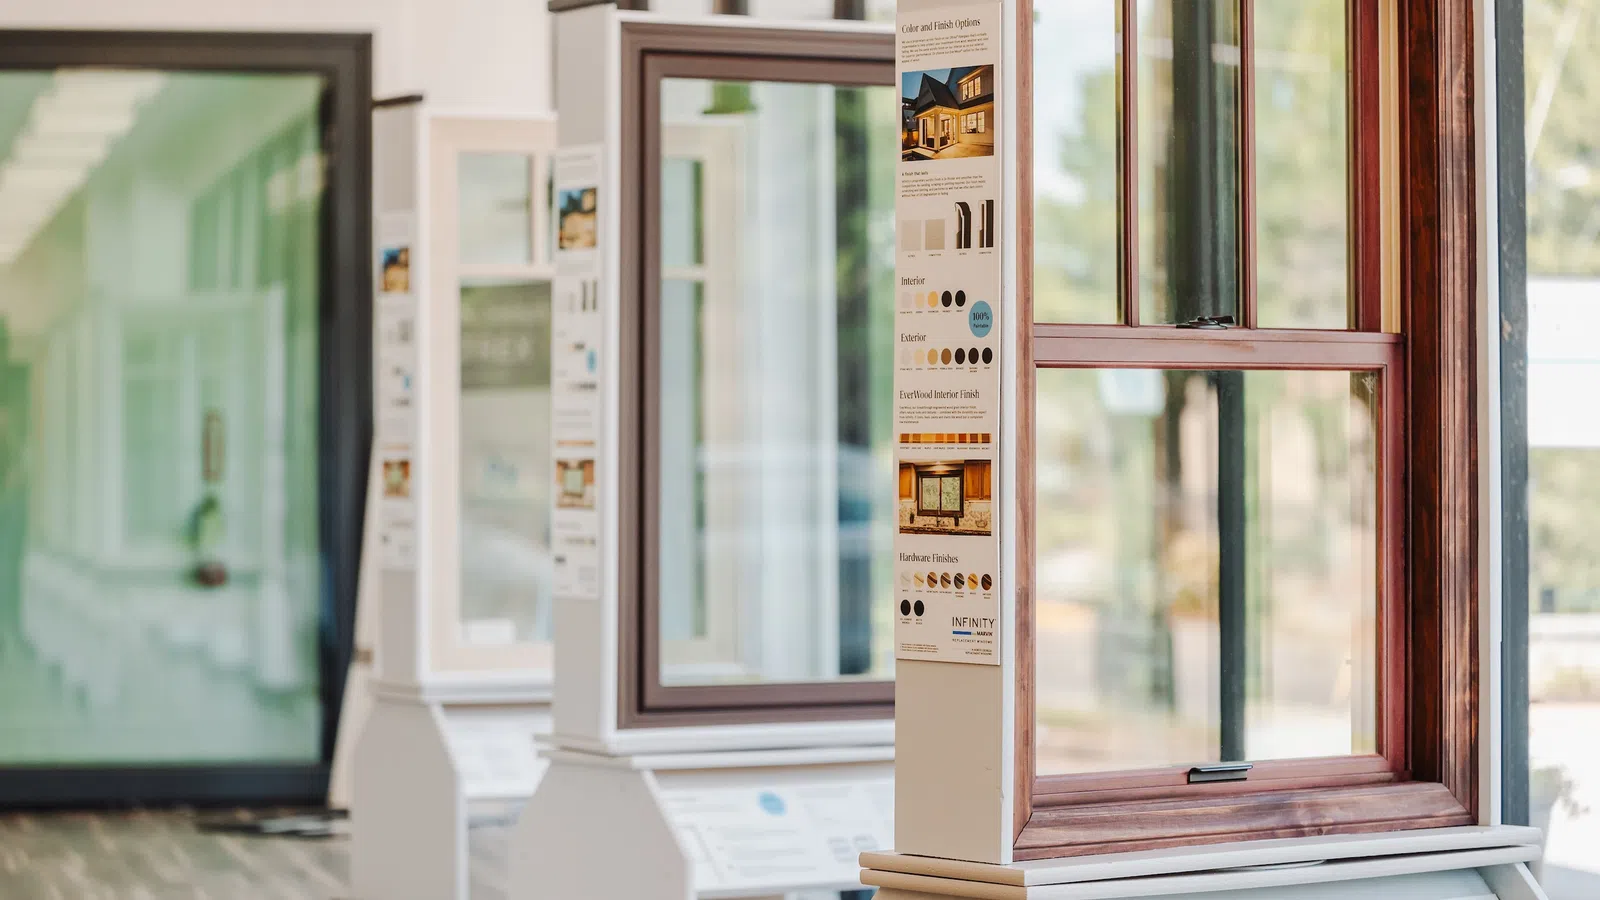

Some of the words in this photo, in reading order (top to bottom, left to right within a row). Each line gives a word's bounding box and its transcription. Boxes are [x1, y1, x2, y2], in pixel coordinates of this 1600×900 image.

[901, 24, 919, 34] Color
[920, 22, 932, 32] and
[934, 20, 954, 30] Finish
[954, 18, 980, 30] Options
[901, 276, 926, 286] Interior
[972, 312, 990, 320] 100%
[900, 333, 926, 342] Exterior
[900, 390, 932, 399] EverWood
[934, 390, 958, 399] Interior
[960, 390, 980, 398] Finish
[900, 552, 931, 562] Hardware
[932, 554, 959, 563] Finishes
[952, 616, 994, 628] INFINITY
